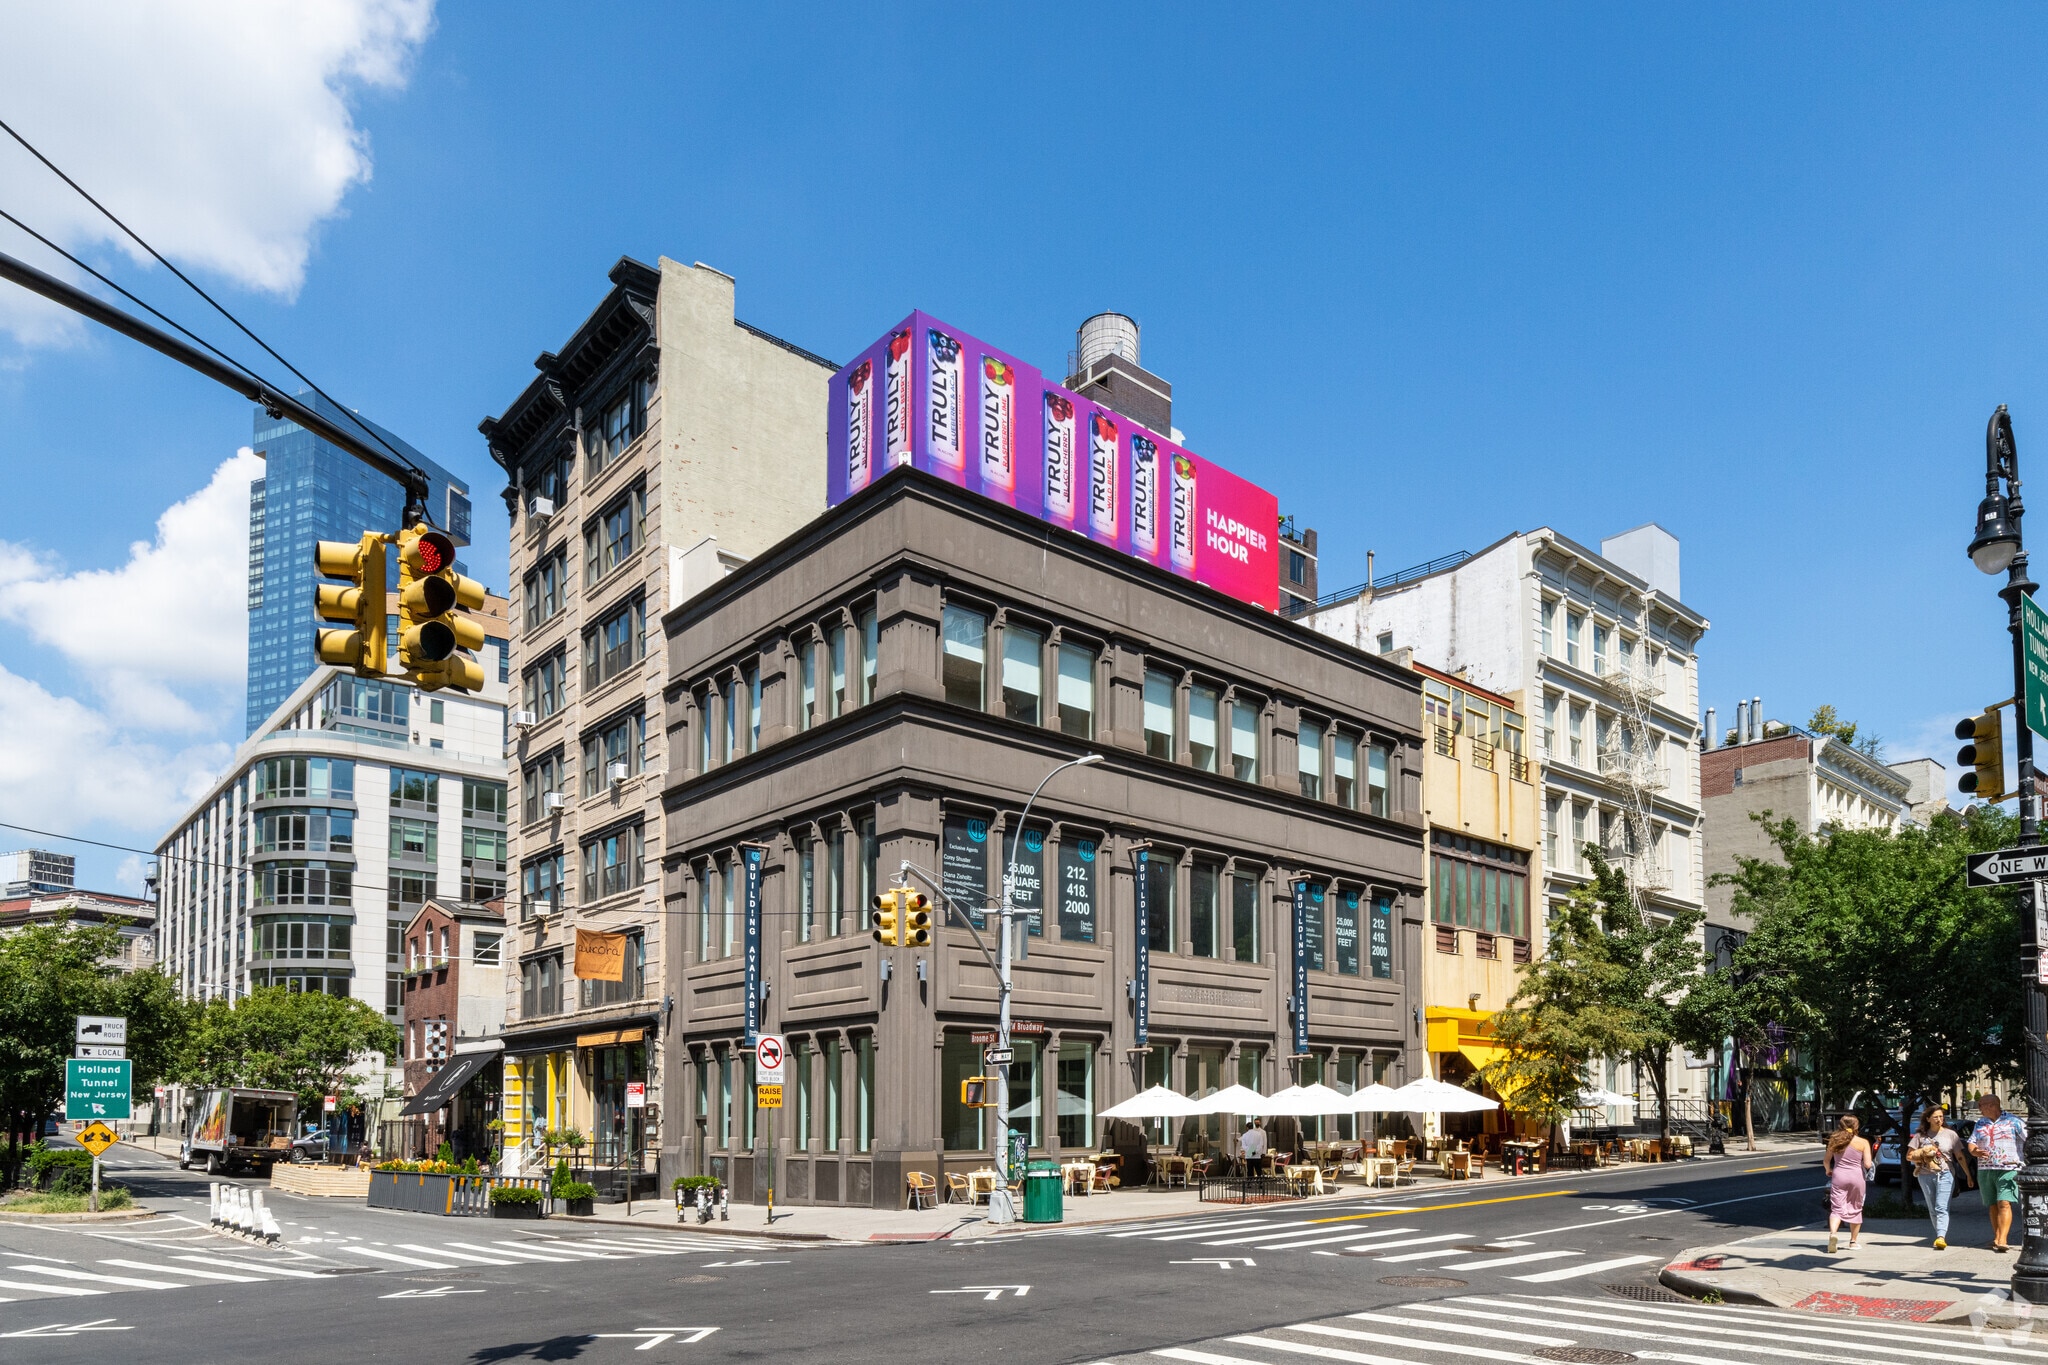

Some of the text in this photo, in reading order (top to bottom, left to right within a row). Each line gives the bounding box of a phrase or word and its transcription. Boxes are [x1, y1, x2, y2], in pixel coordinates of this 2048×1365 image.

[932, 359, 947, 442] TRULY
[887, 371, 899, 454] TRULY
[985, 383, 1000, 464] TRULY
[849, 398, 861, 480] TRULY
[1047, 418, 1061, 496] TRULY
[1093, 440, 1106, 514] TRULY
[1134, 460, 1147, 532] TRULY
[1174, 478, 1186, 549] TRULY
[1206, 507, 1267, 552] HAPPIER
[1206, 529, 1249, 564] HOUR
[2028, 660, 2038, 677] NEW
[1066, 865, 1088, 881] 212.
[1988, 859, 2023, 875] ONE
[1066, 883, 1088, 898] 418.
[748, 863, 756, 935] BUILDING
[1065, 900, 1090, 915] 2000
[1336, 917, 1353, 927] 25,000
[1372, 918, 1387, 930] 212.
[1337, 938, 1353, 947] FEET
[1372, 931, 1387, 944] 418.
[1371, 945, 1388, 957] 2000
[748, 945, 756, 1027] AVAILABLE
[1017, 1022, 1043, 1033] Broadway
[971, 1034, 995, 1043] Broome St
[97, 1048, 122, 1057] LOCAL
[78, 1065, 121, 1074] Holland
[81, 1078, 118, 1087] Tunnel
[70, 1091, 127, 1100] New Jersey
